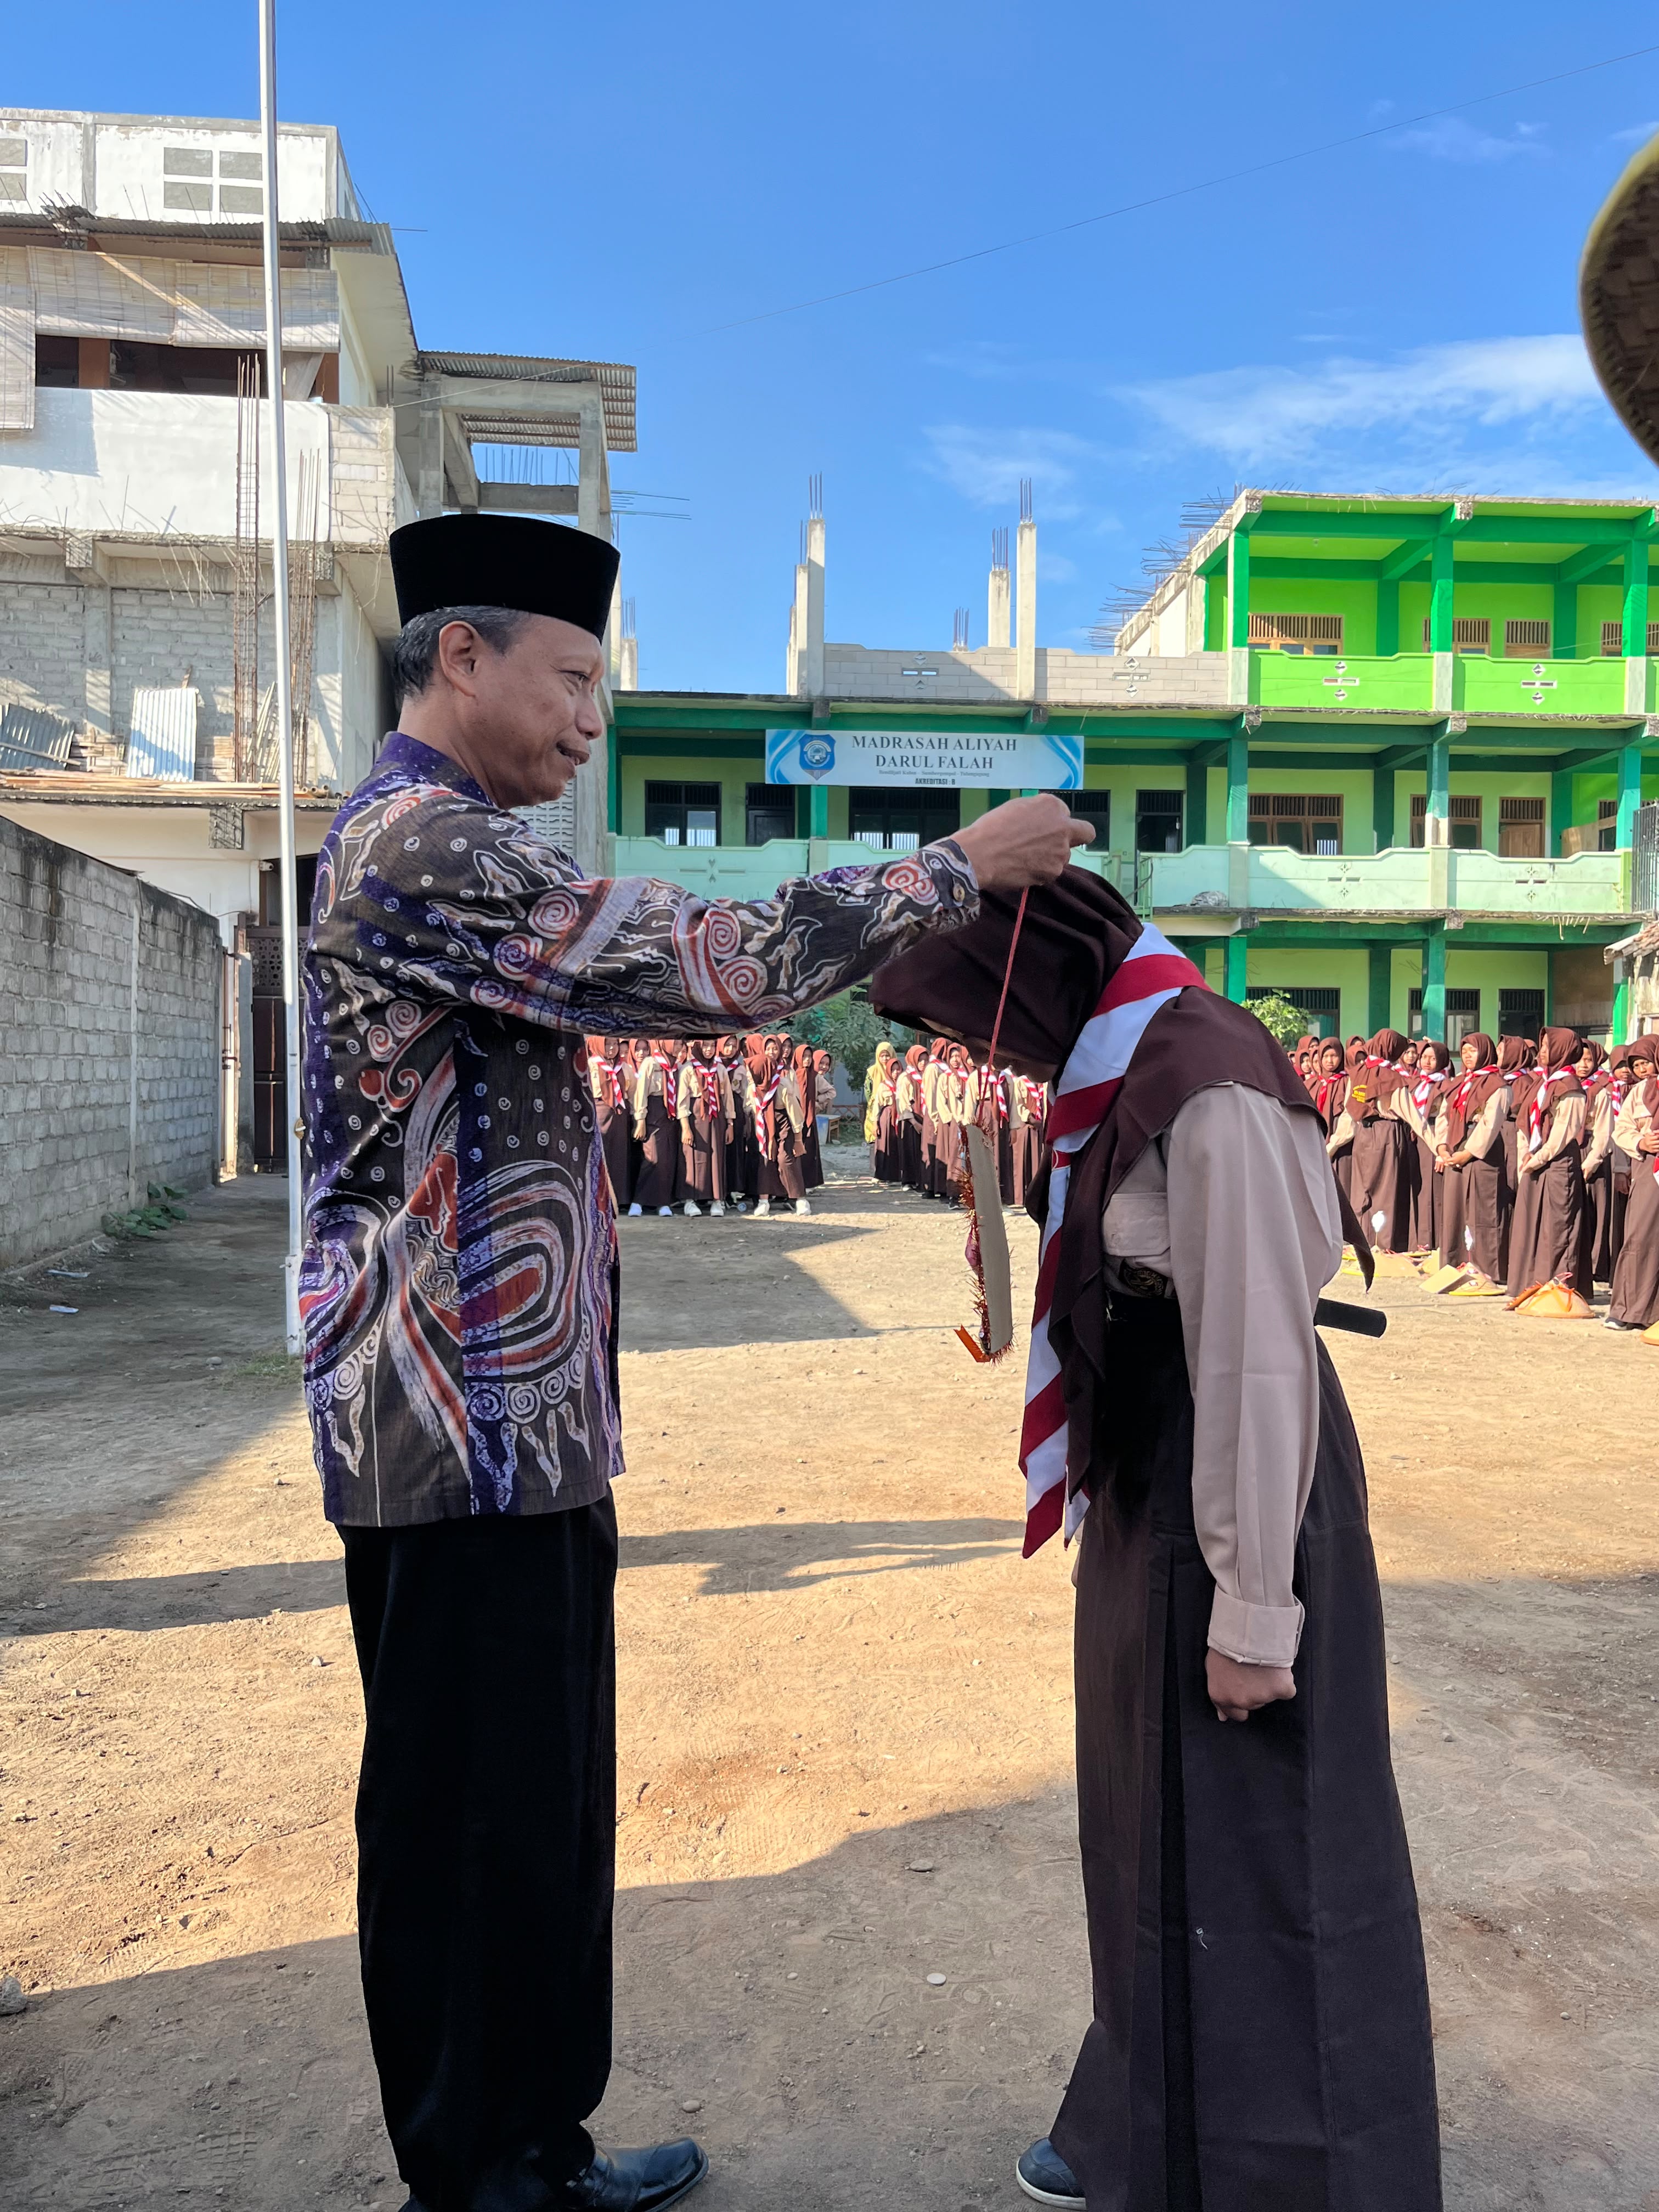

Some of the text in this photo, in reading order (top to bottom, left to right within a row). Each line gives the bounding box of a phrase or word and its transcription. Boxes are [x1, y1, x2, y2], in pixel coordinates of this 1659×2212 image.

[851, 736, 1017, 751] MADRASAH ALIYAH
[876, 755, 994, 769] DARUL FALAH
